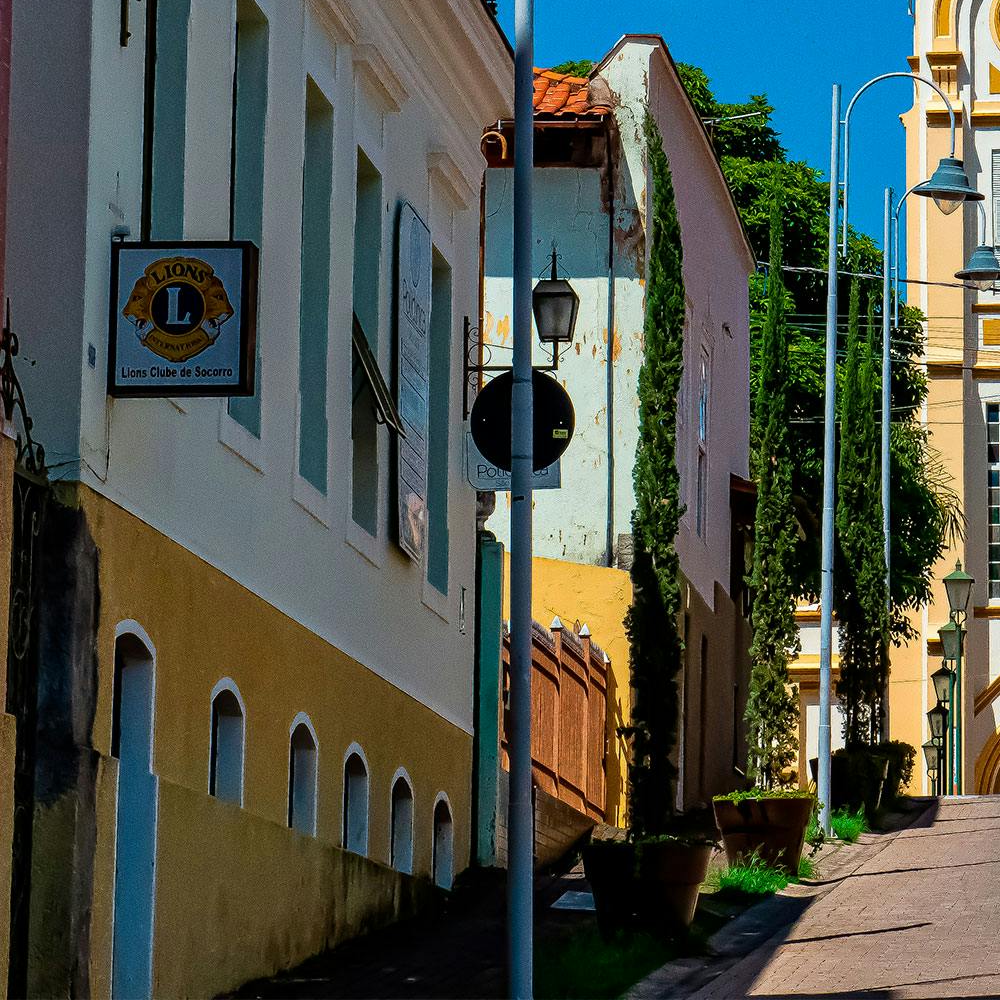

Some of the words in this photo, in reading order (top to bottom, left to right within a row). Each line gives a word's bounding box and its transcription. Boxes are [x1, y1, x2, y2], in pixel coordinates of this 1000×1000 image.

[151, 262, 208, 285] LIONS
[166, 287, 191, 325] L
[121, 366, 148, 379] Lions
[150, 366, 178, 378] Clube
[179, 366, 193, 378] de
[194, 366, 233, 378] Socorro
